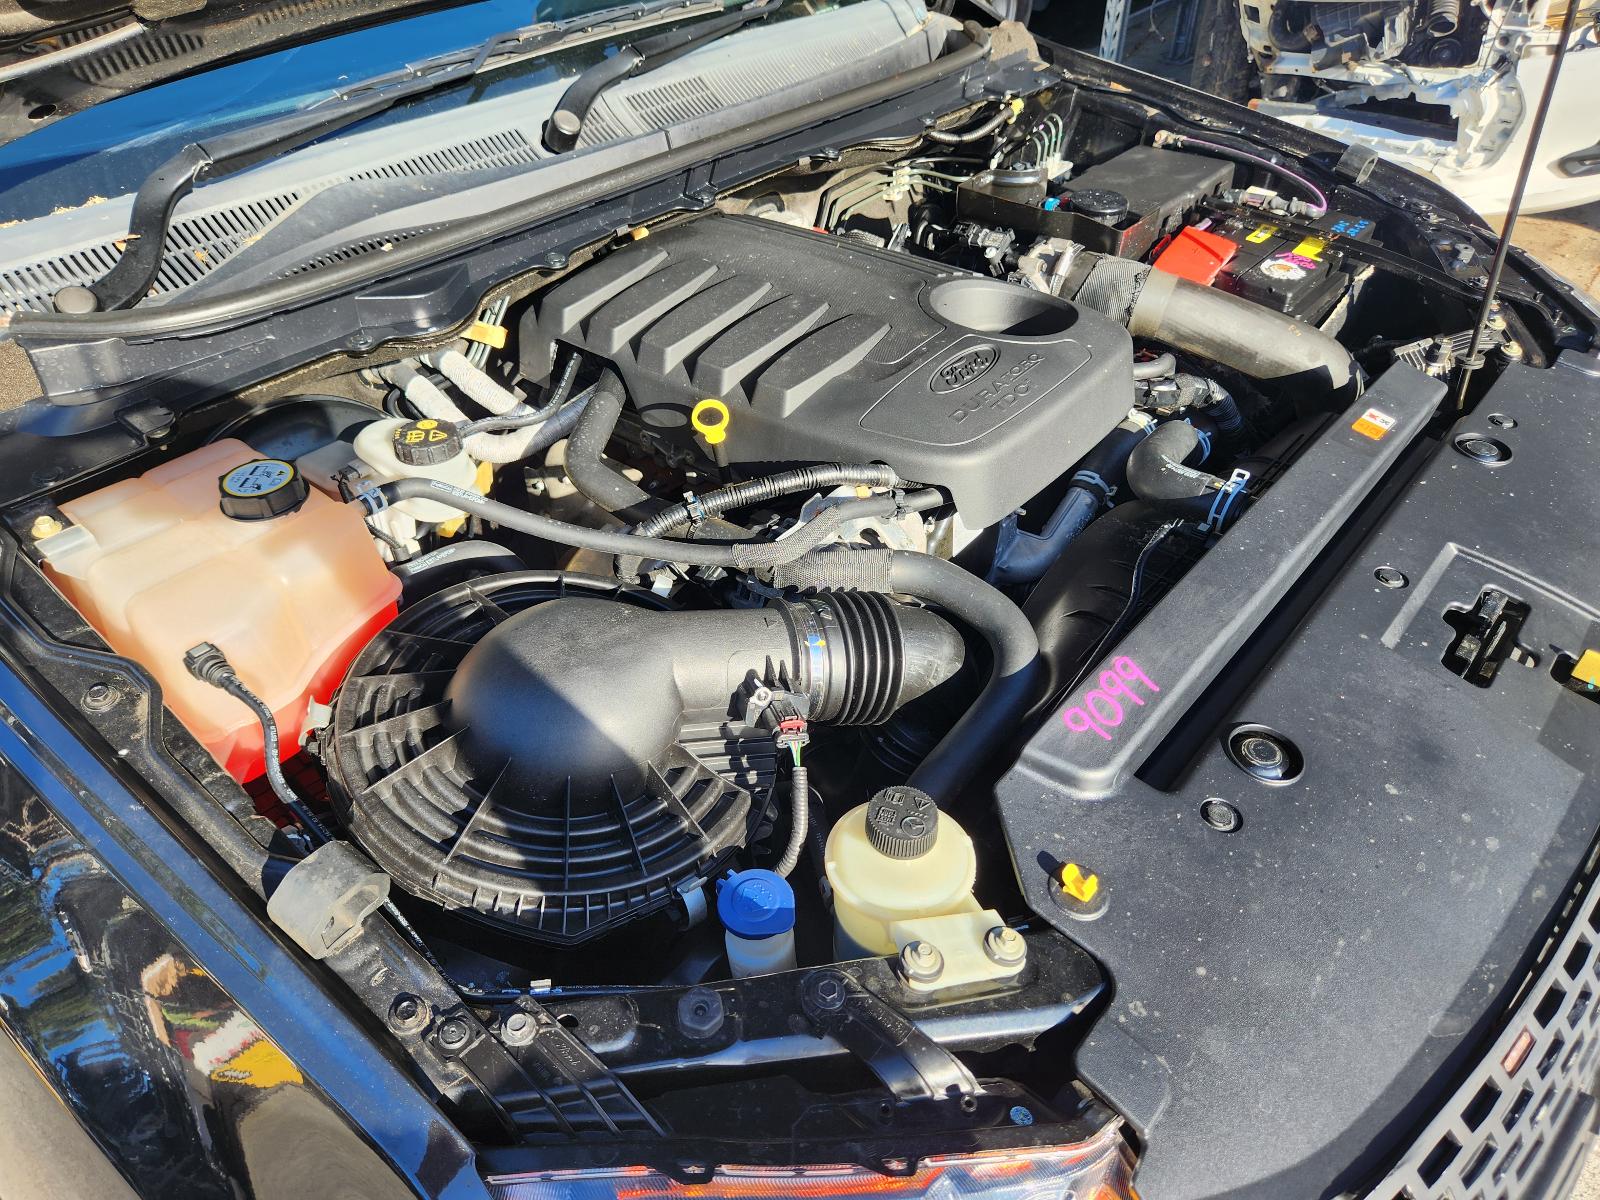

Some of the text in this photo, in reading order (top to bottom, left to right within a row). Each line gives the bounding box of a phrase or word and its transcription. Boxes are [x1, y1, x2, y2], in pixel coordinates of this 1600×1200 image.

[940, 352, 990, 388] Ford
[947, 353, 1046, 424] DURATORQ
[1063, 655, 1160, 741] 9099
